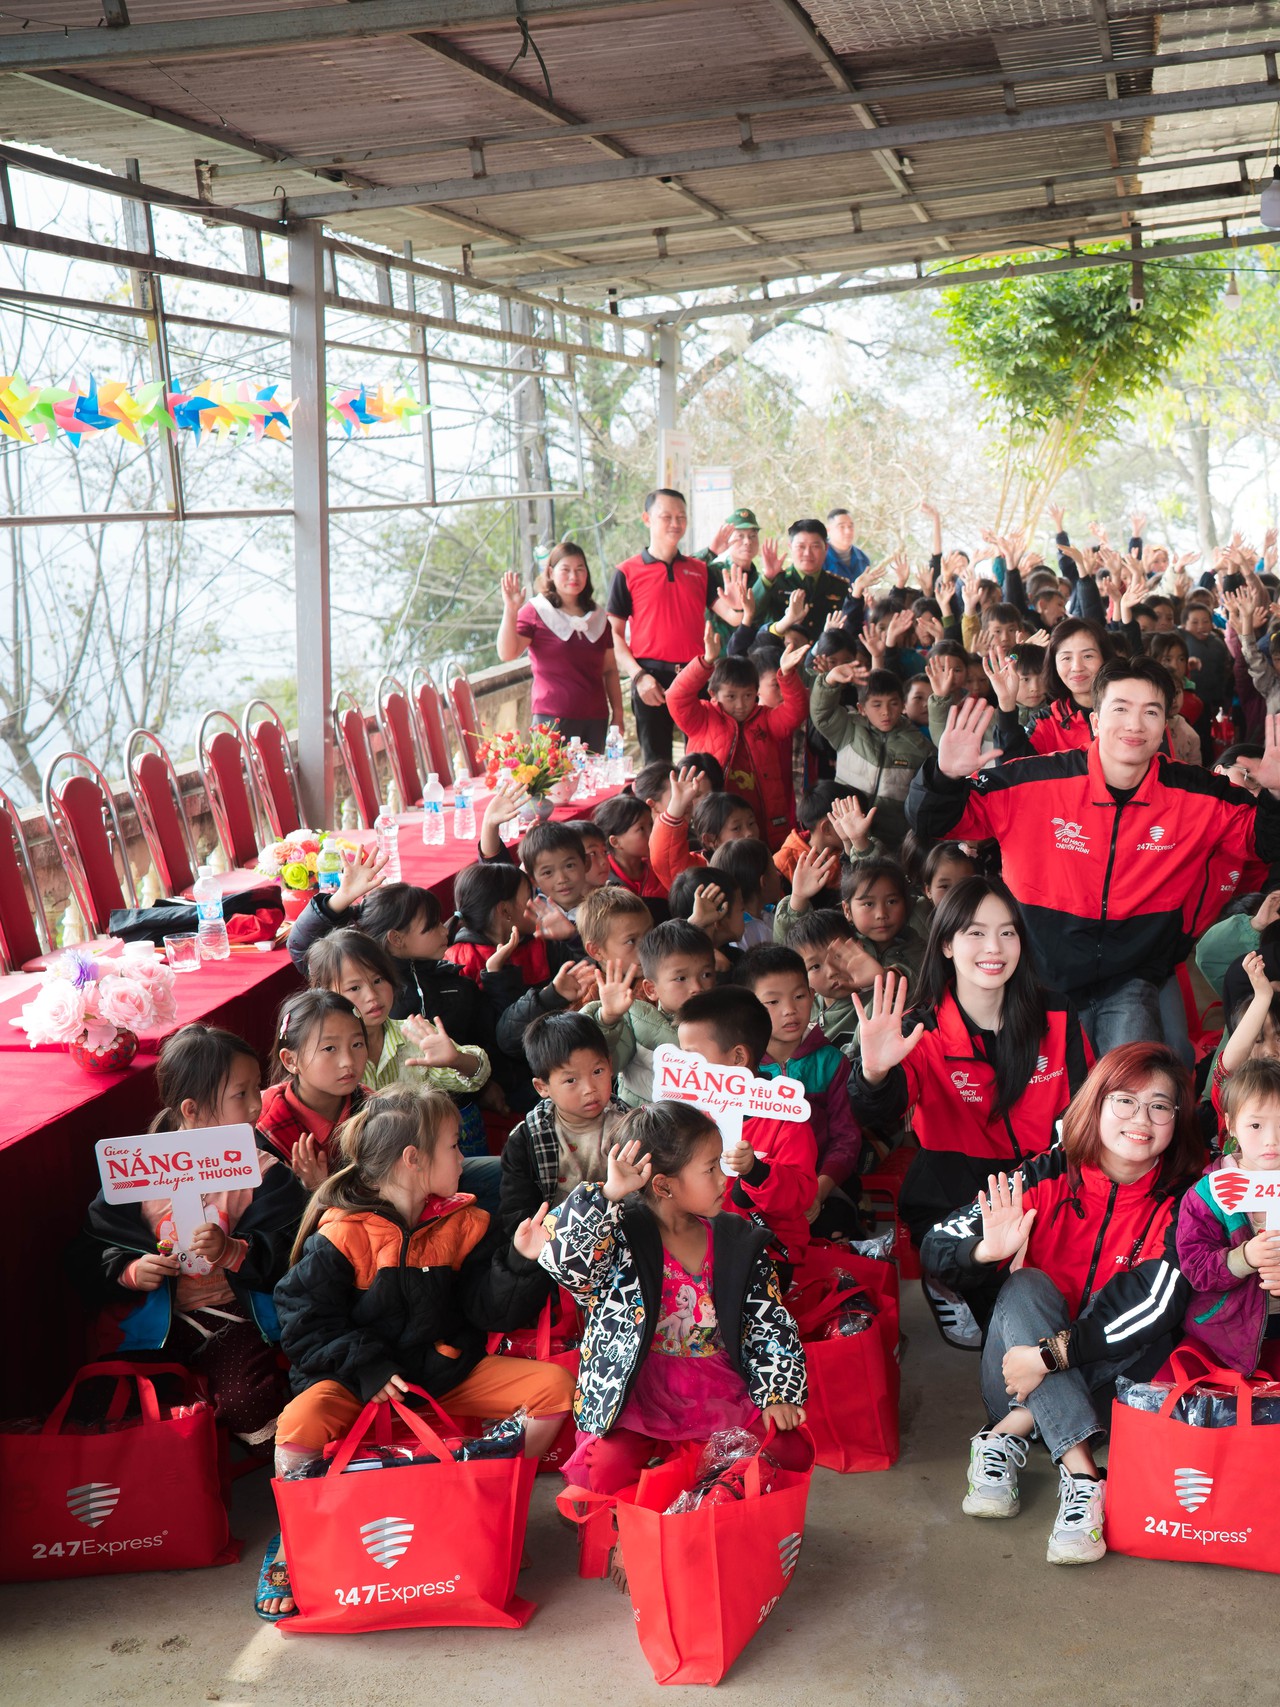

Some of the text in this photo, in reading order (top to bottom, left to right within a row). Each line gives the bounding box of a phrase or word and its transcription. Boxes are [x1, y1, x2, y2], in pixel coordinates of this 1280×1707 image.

[661, 1061, 746, 1096] NẮNG
[750, 1086, 773, 1099] YÊU
[748, 1099, 802, 1115] THƯƠNG
[104, 1145, 130, 1157] Giao
[106, 1148, 194, 1180] NẮNG
[197, 1157, 220, 1169] YÊU
[198, 1165, 253, 1181] THƯƠNG
